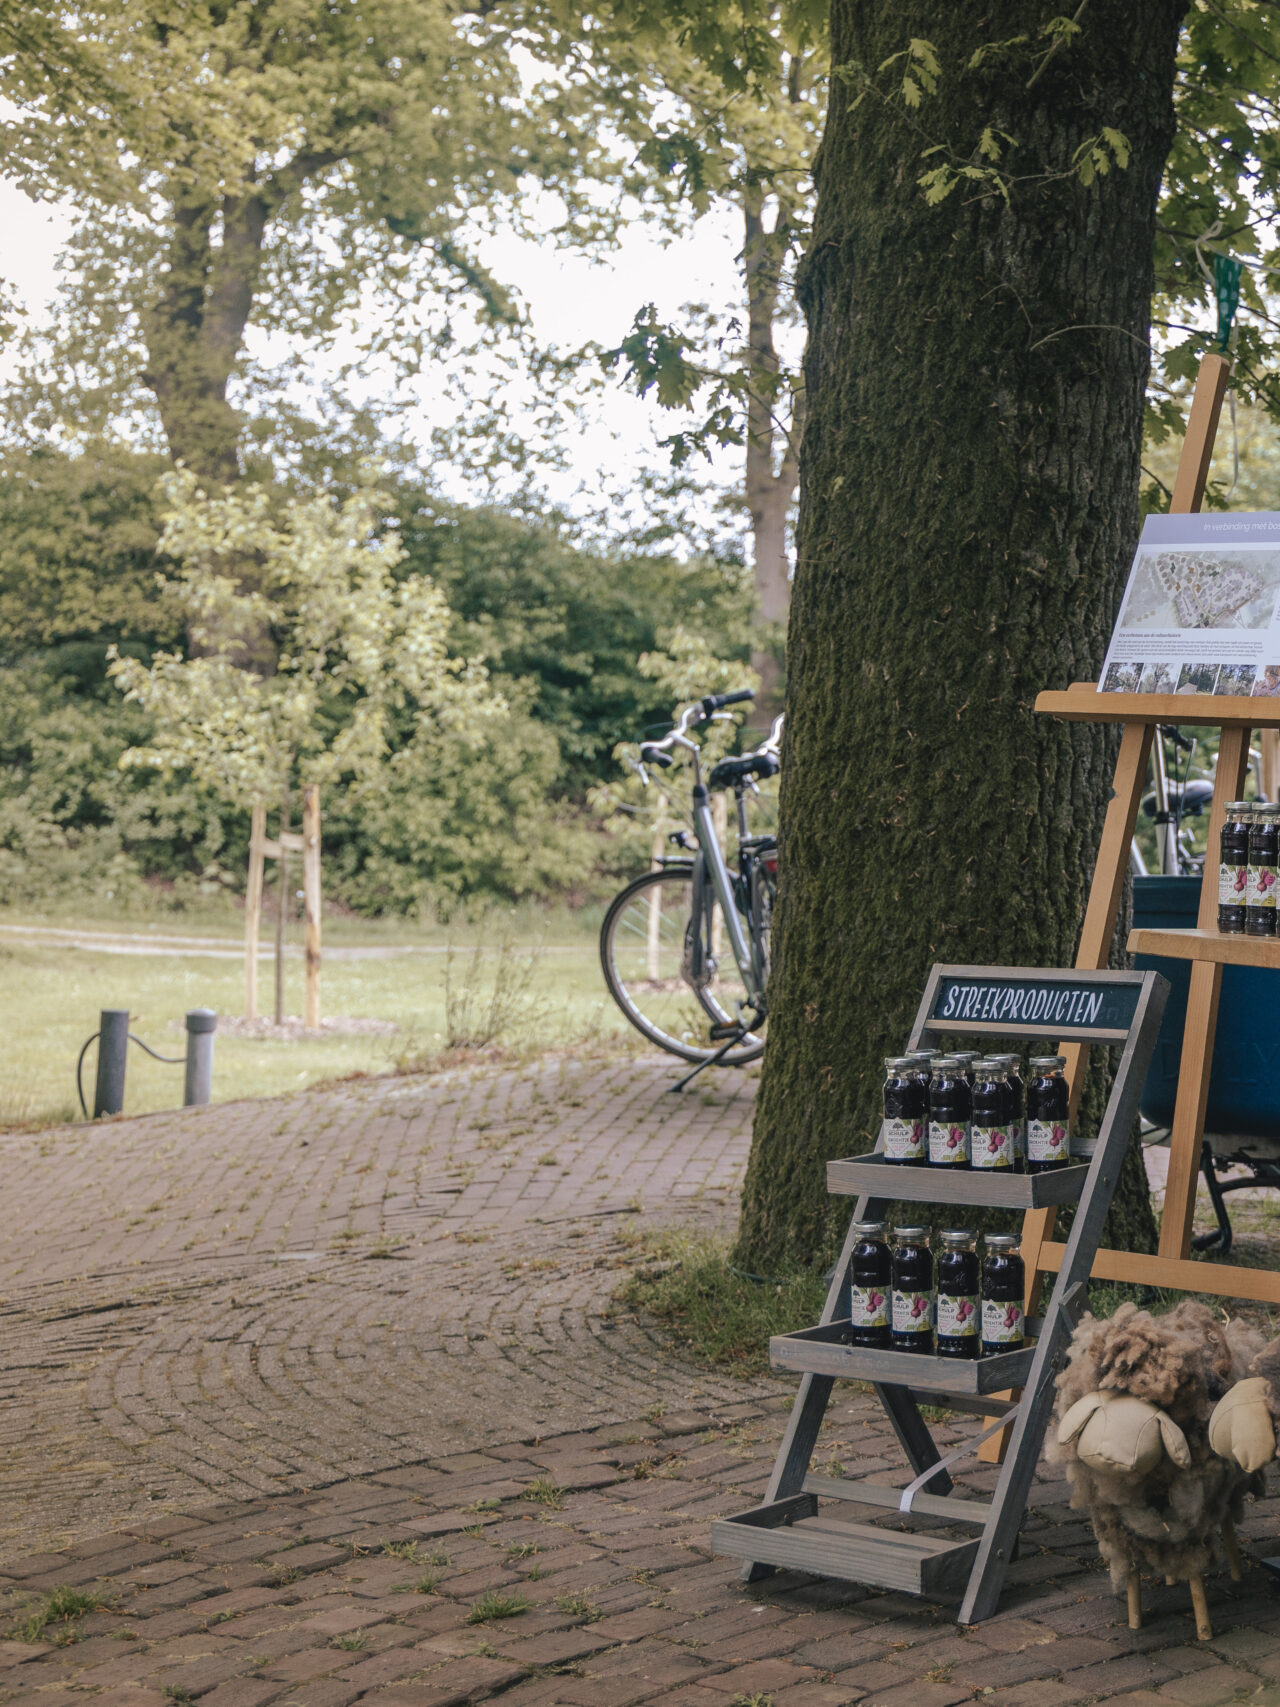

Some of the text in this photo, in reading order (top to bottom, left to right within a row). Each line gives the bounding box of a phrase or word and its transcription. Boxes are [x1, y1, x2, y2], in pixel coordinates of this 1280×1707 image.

[1203, 522, 1211, 531] In
[1212, 520, 1250, 533] verbinding
[1251, 521, 1267, 531] met
[943, 984, 1104, 1024] STREEKPRODUCTEN
